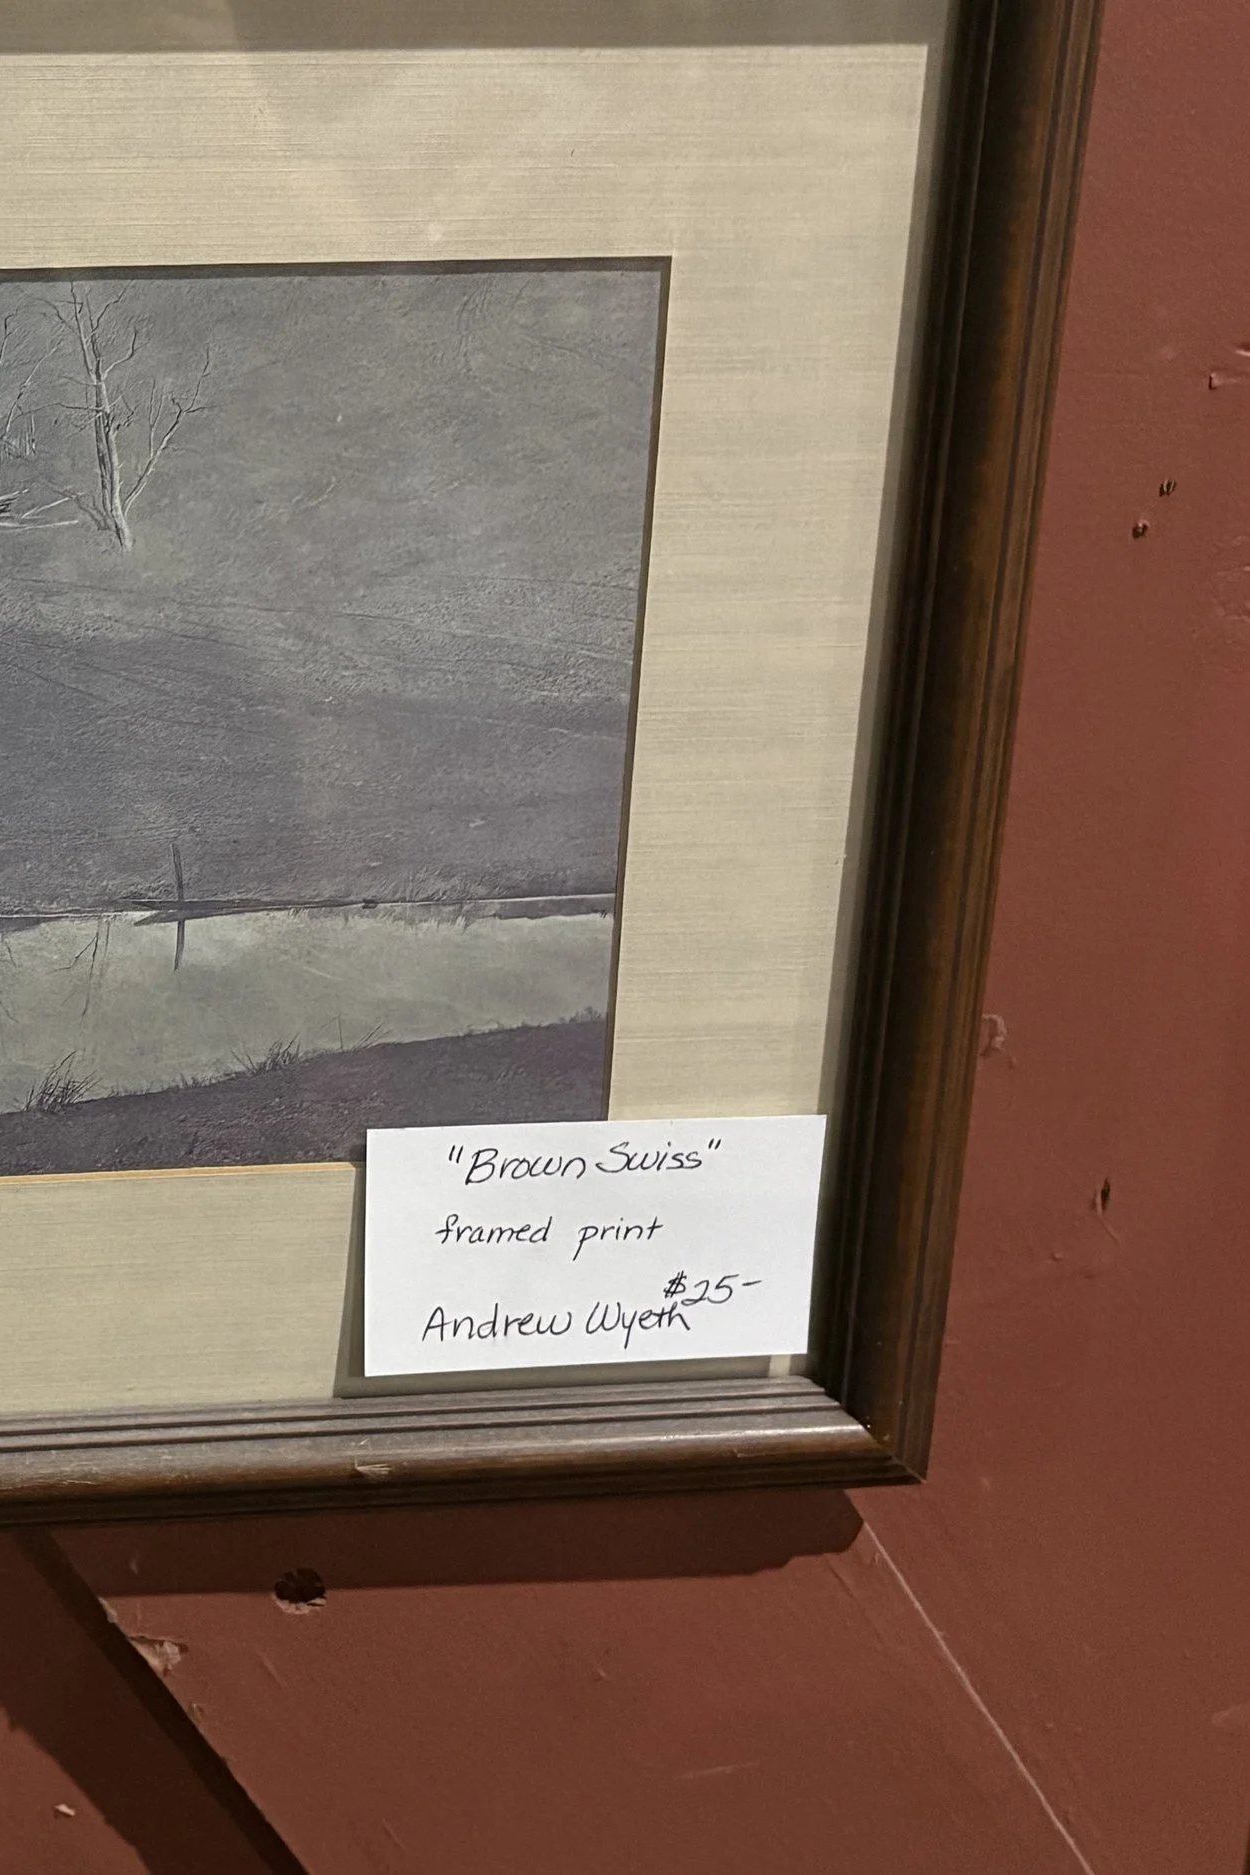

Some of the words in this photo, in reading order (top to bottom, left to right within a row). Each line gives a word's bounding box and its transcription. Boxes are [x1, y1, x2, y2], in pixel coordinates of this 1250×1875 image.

[448, 1145, 586, 1185] "Brown
[596, 1139, 722, 1174] Swiss"
[435, 1213, 553, 1244] framed
[572, 1216, 664, 1261] print
[422, 1303, 572, 1342] Andrew
[585, 1301, 691, 1349] Wyeth
